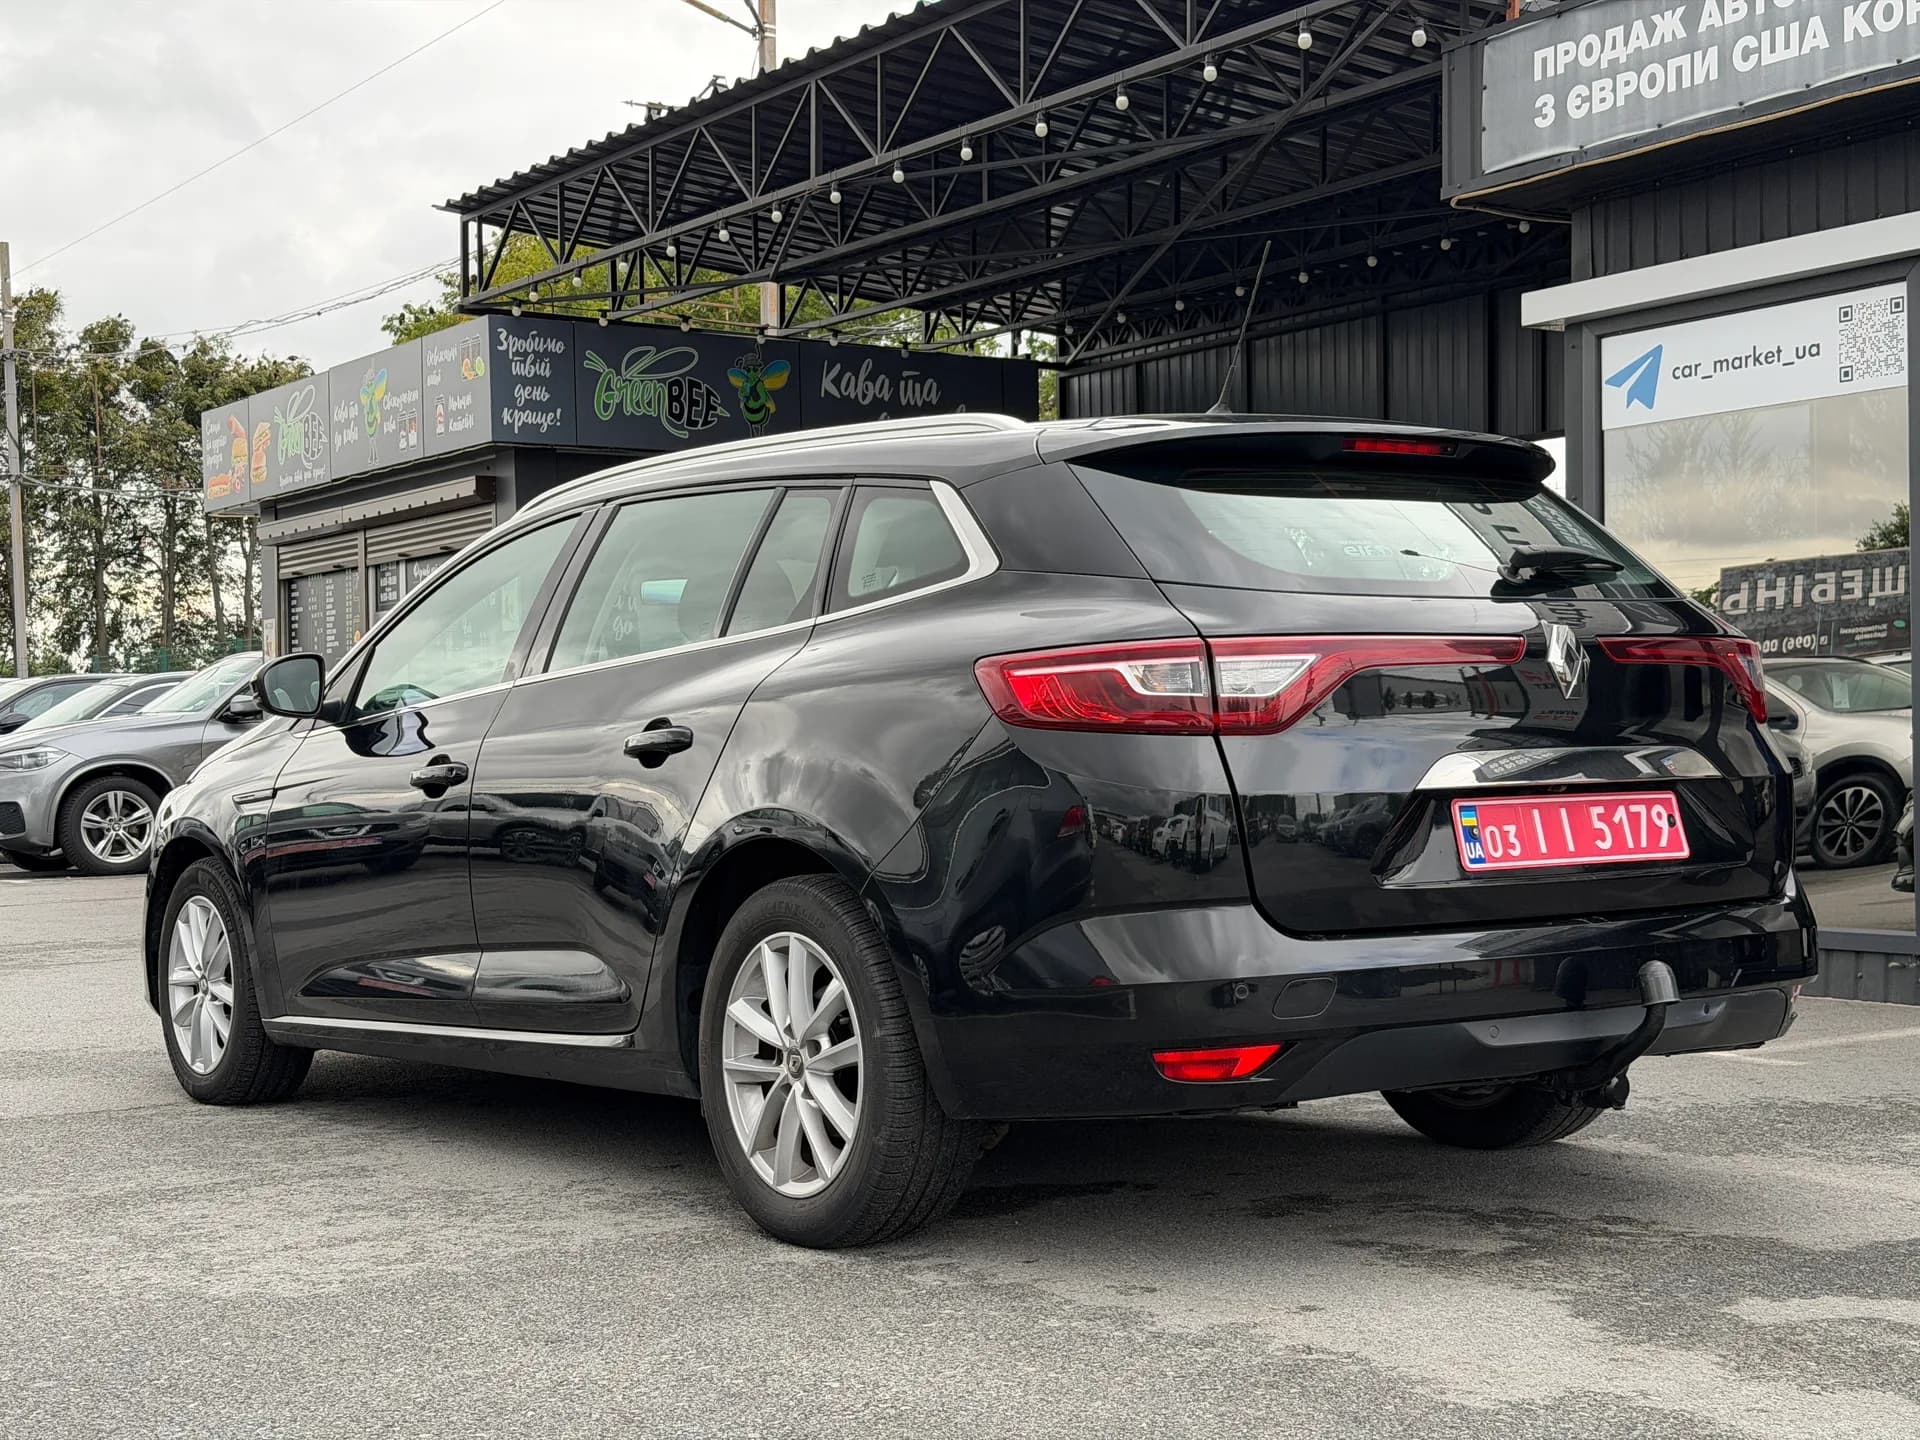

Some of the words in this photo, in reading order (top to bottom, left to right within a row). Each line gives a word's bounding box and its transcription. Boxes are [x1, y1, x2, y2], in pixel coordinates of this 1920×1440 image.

[1533, 4, 1688, 82] ПРОДАЖ
[1697, 0, 1795, 33] АВ
[1533, 93, 1556, 129] З
[1566, 44, 1719, 120] ЄВРОПИ
[1731, 15, 1830, 73] США
[496, 327, 566, 359] Зробимо
[511, 355, 552, 379] твій
[1672, 343, 1821, 380] car_market_ua
[513, 383, 551, 407] день
[820, 357, 896, 406] Кава
[898, 370, 943, 407] та
[501, 406, 563, 434] краще!
[1485, 824, 1521, 858] 03
[1590, 803, 1672, 850] 5179
[1466, 841, 1485, 859] UA
